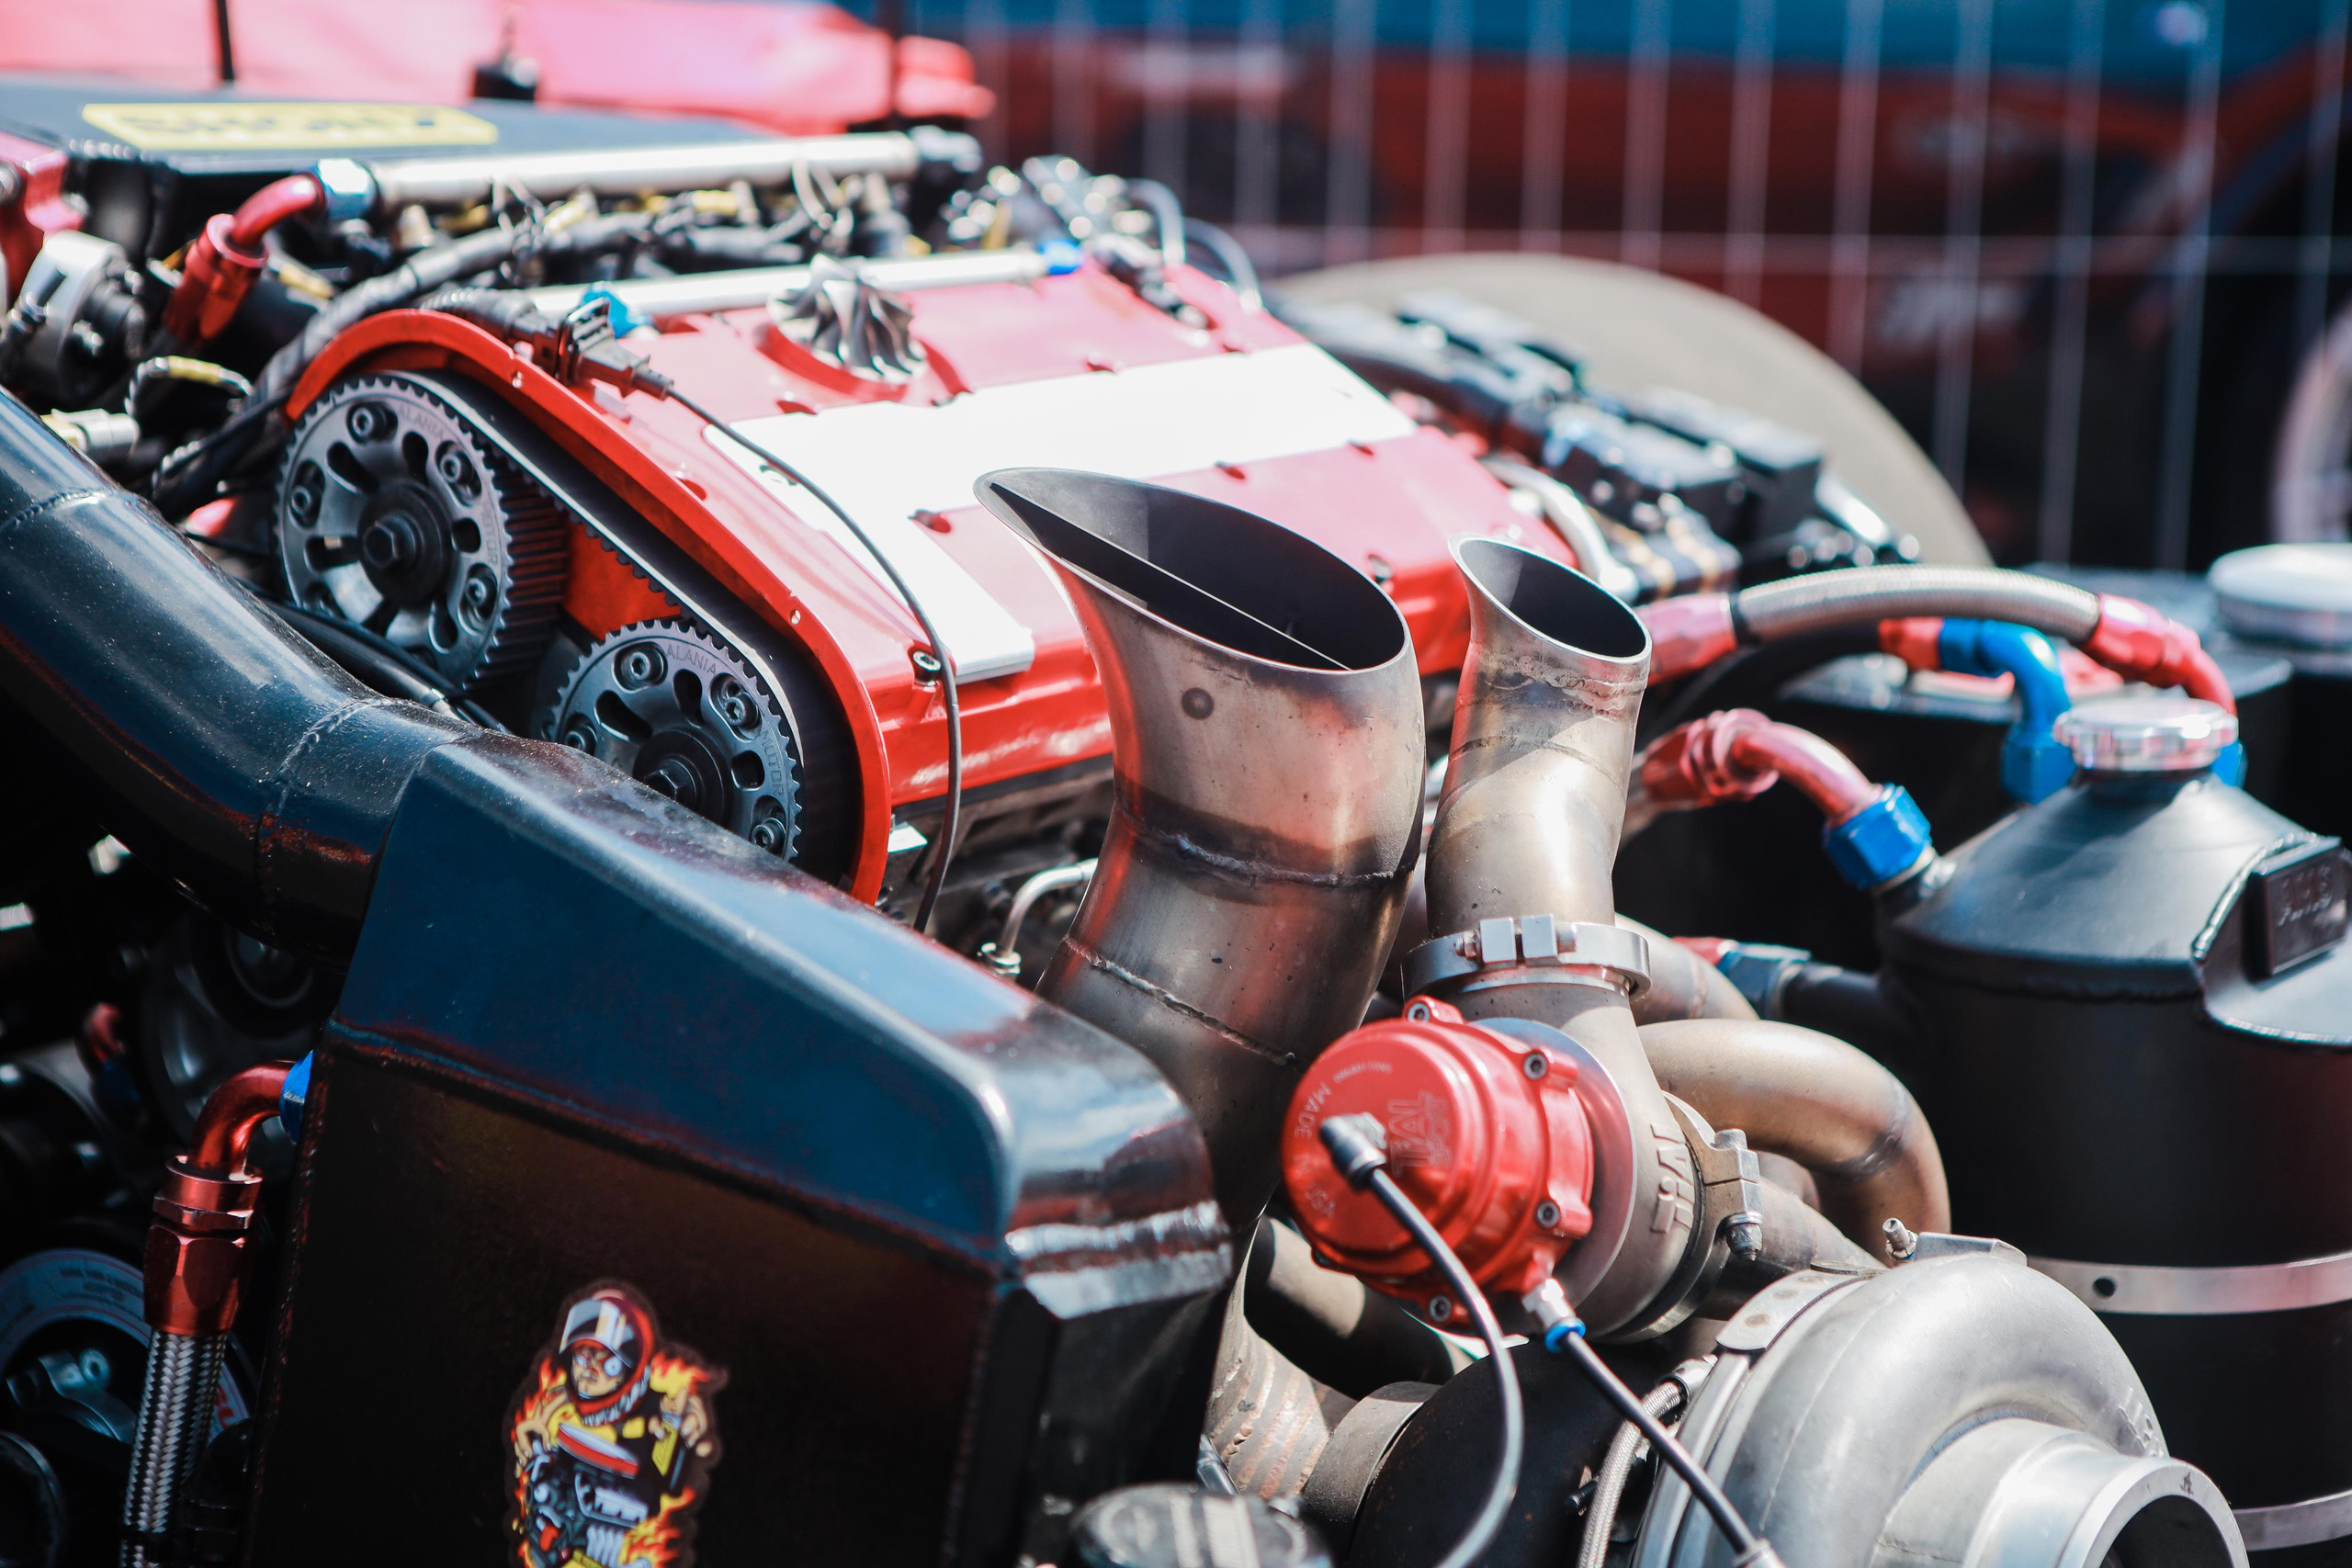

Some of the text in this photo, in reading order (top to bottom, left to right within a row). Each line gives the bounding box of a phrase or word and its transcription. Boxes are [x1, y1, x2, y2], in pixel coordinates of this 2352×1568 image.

[480, 502, 498, 565] MOTOR
[666, 644, 785, 796] ALANIA MOTOR
[1294, 1081, 1332, 1139] MADE
